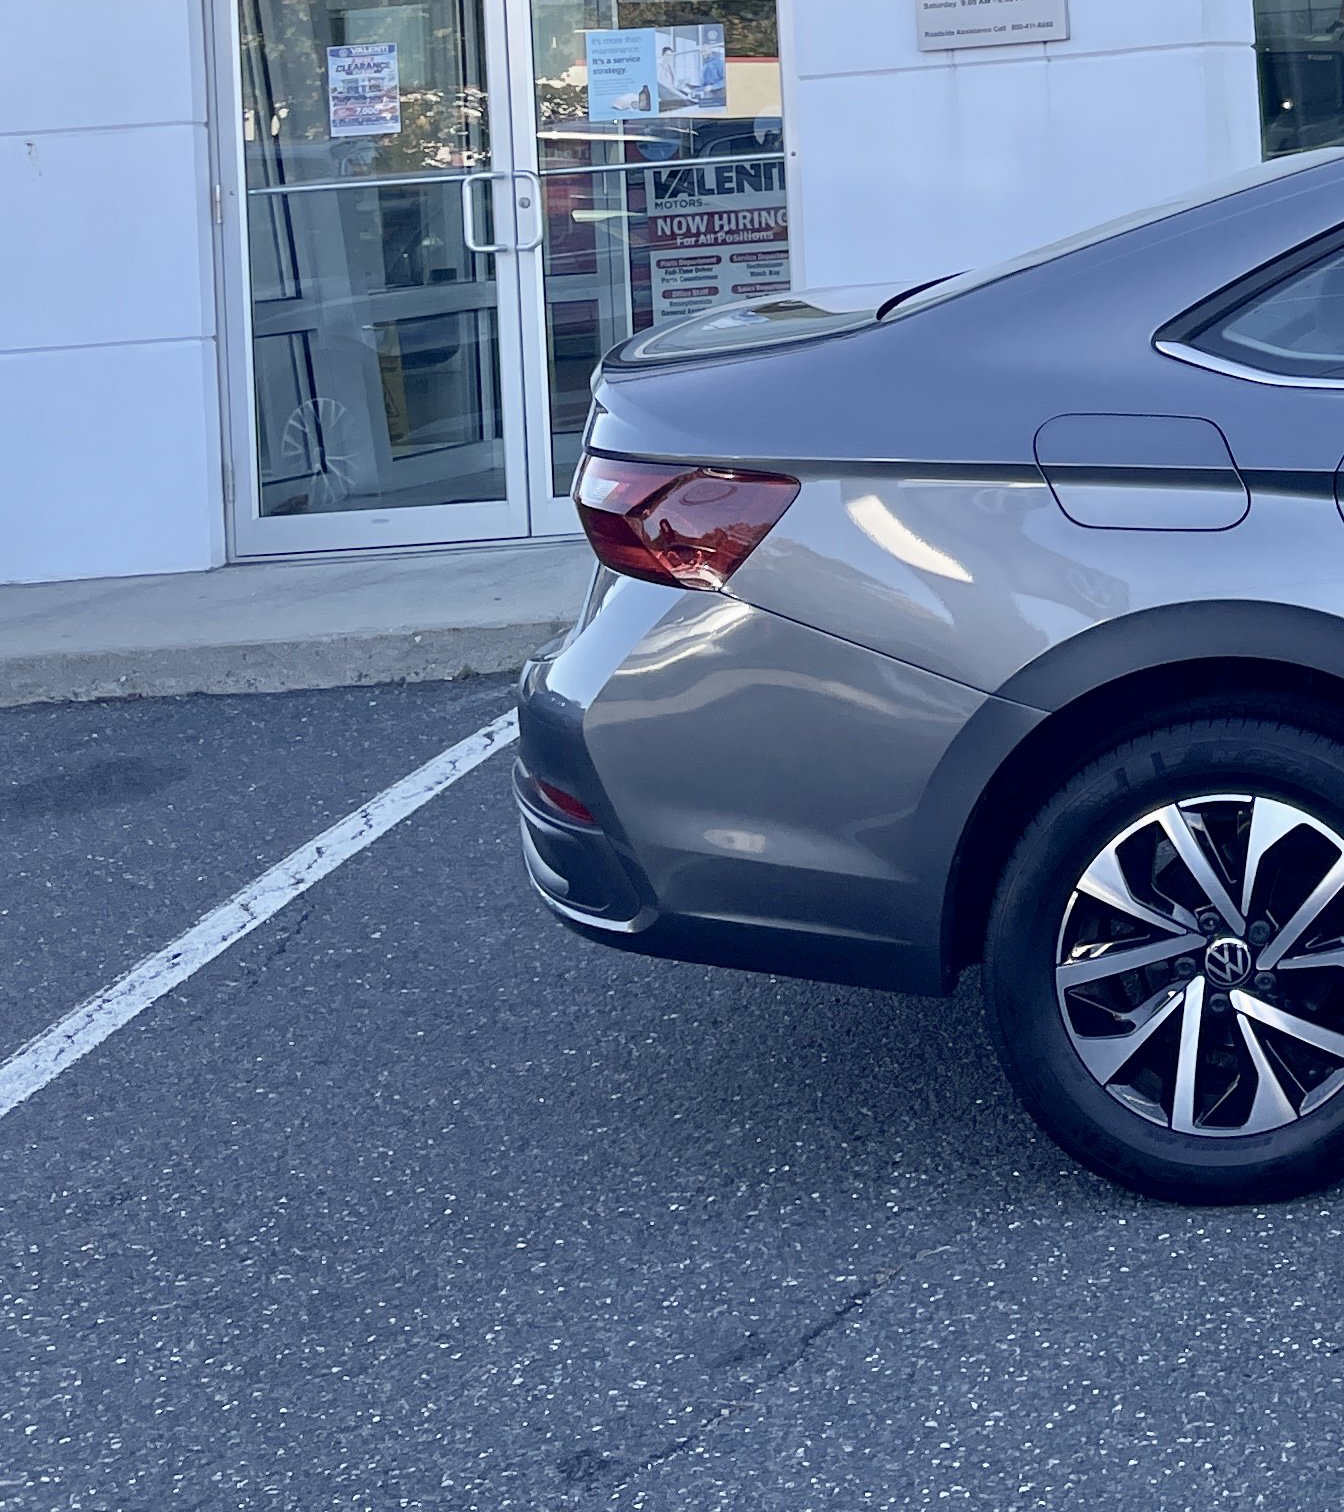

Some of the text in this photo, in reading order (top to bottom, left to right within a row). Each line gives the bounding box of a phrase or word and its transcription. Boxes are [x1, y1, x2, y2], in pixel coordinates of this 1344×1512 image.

[923, 1, 957, 9] Saturday
[592, 57, 605, 65] It's
[655, 198, 703, 211] MOTORS
[656, 209, 788, 236] NOW HIRING
[677, 230, 774, 246] For All Positions
